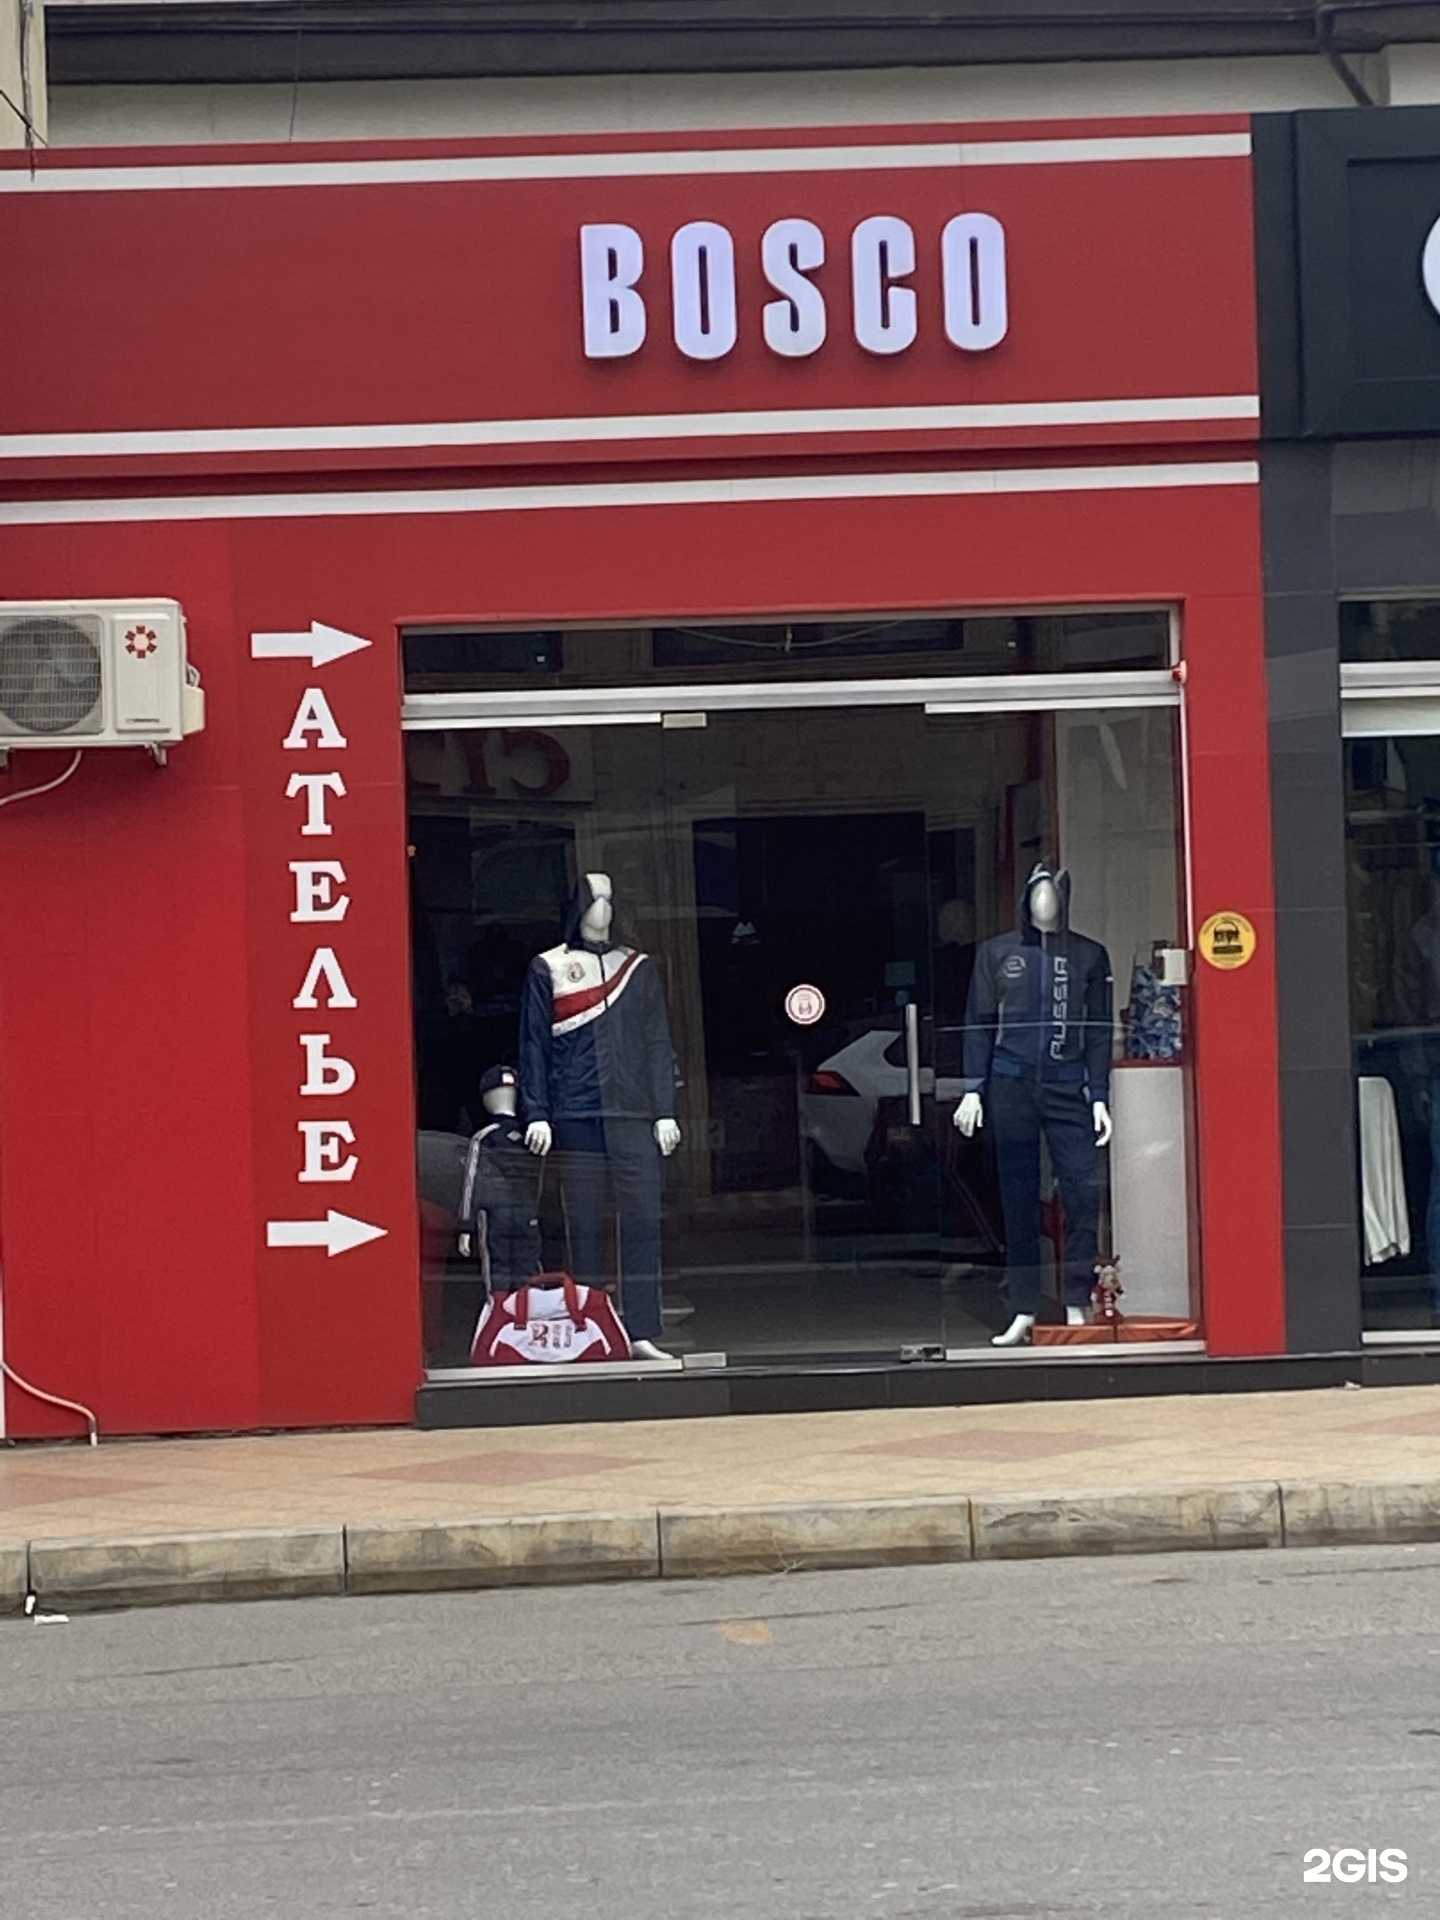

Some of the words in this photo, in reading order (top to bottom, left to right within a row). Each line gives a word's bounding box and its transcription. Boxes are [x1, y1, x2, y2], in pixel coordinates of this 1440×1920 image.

[580, 212, 1008, 361] BOSCO
[283, 688, 358, 1183] АТЕЛЬЕ
[1049, 955, 1069, 1061] RUSSIA
